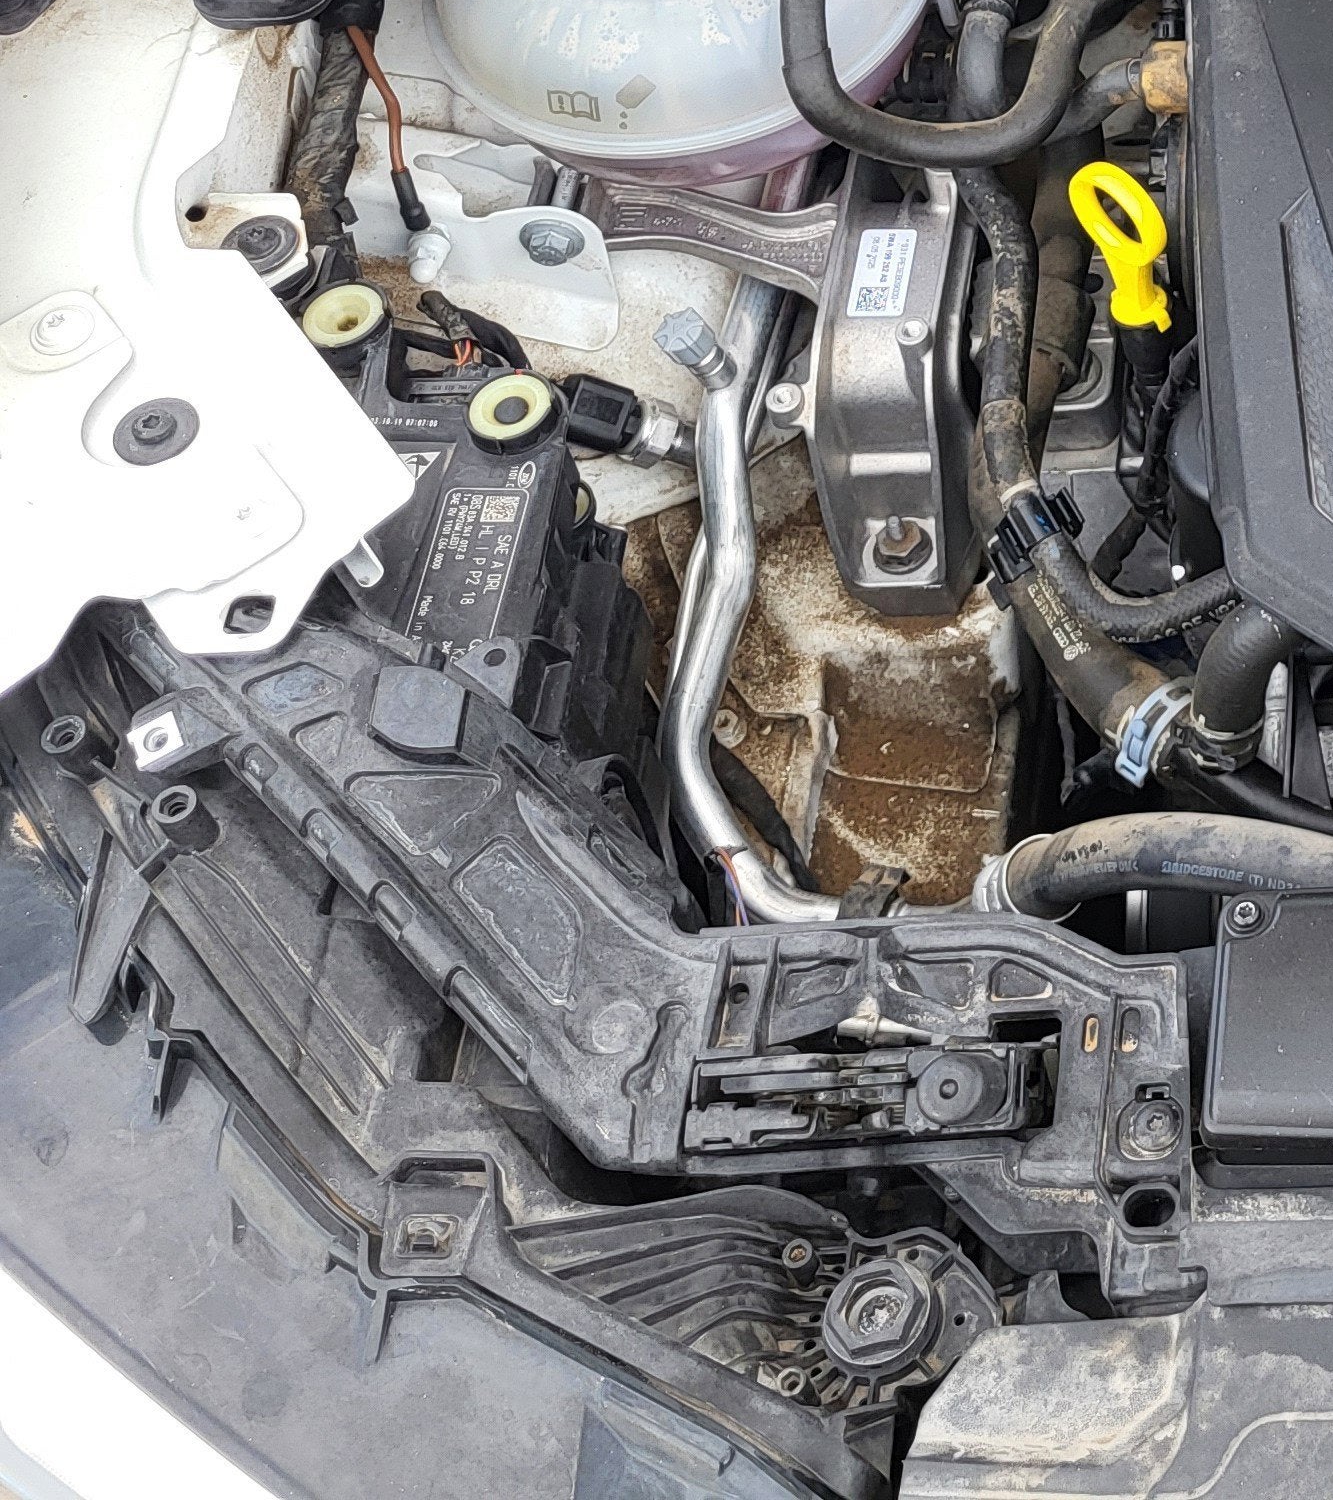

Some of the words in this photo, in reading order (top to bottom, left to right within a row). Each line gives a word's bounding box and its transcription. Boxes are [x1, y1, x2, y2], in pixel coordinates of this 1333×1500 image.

[478, 525, 495, 539] HL
[494, 534, 512, 555] SAE
[472, 557, 487, 565] P
[492, 560, 505, 569] A
[465, 570, 483, 585] P2
[482, 574, 502, 594] DRL
[460, 591, 477, 605] 18
[418, 595, 434, 618] Made
